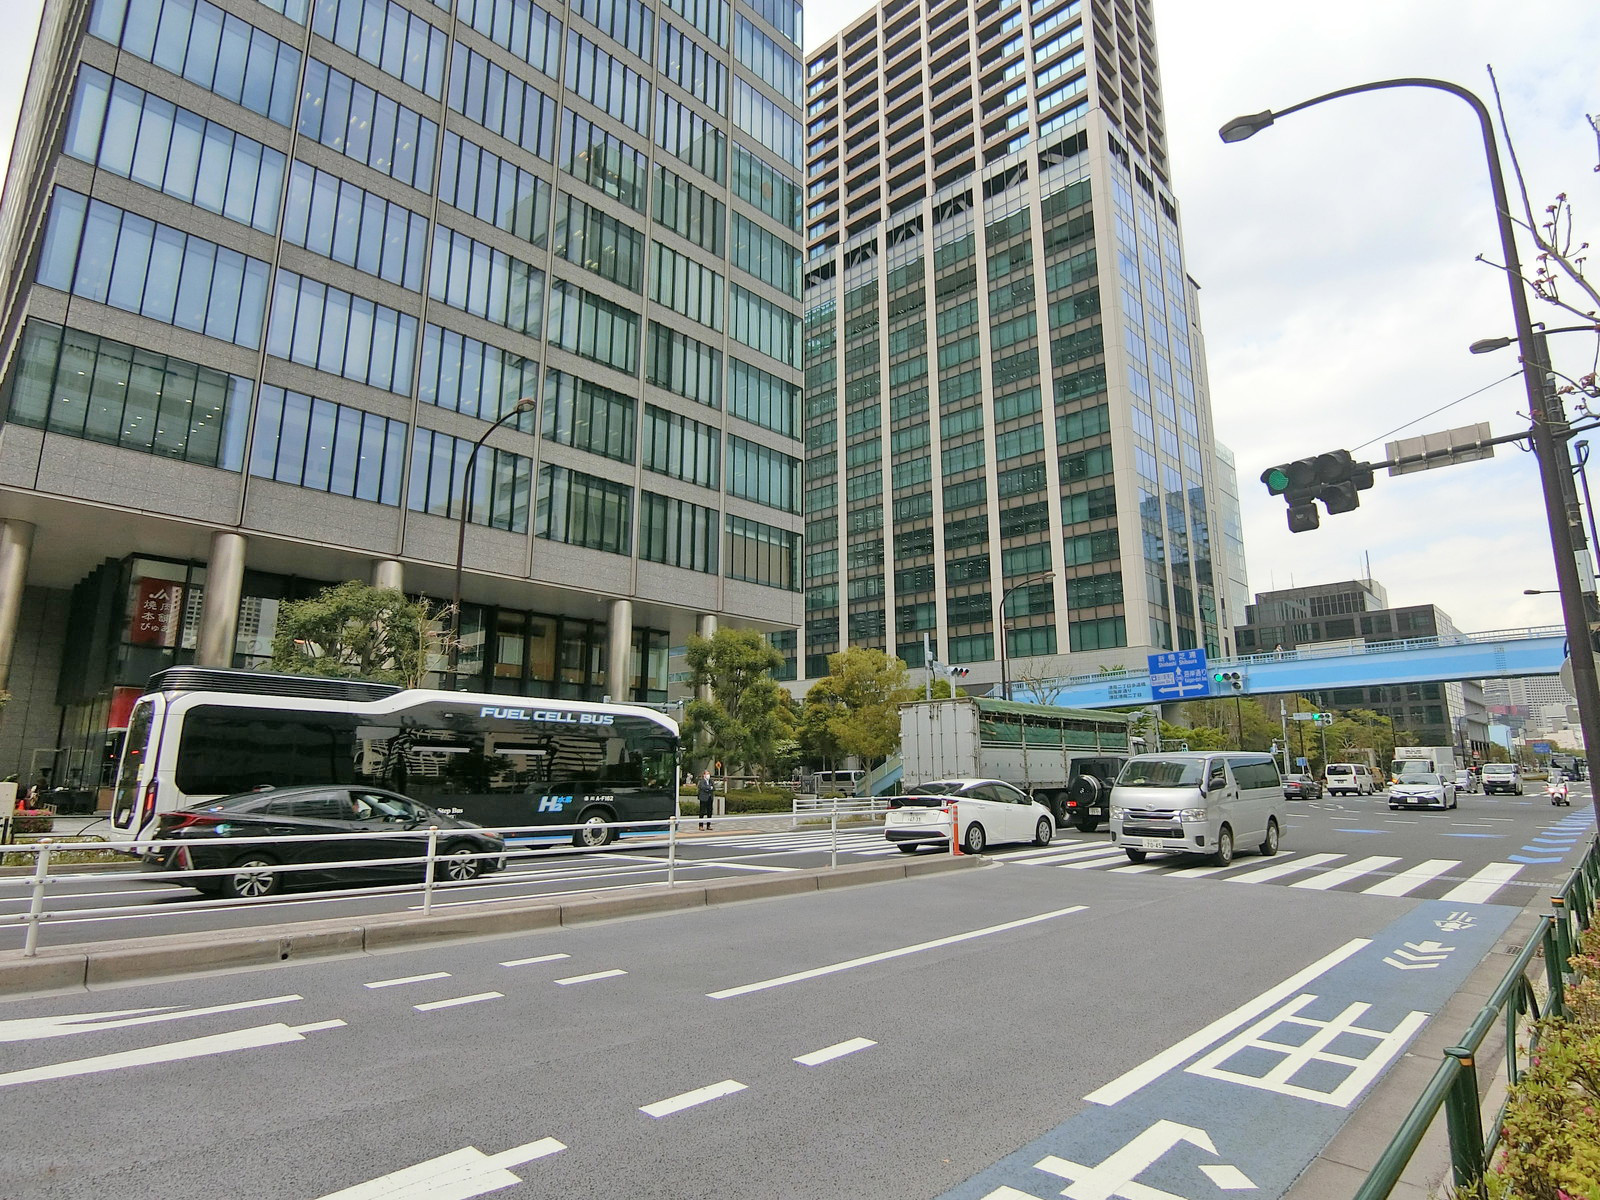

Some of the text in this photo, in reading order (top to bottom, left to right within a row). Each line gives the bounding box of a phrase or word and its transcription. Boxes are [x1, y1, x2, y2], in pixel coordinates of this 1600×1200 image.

[480, 707, 614, 725] FUEL CELL BUS
